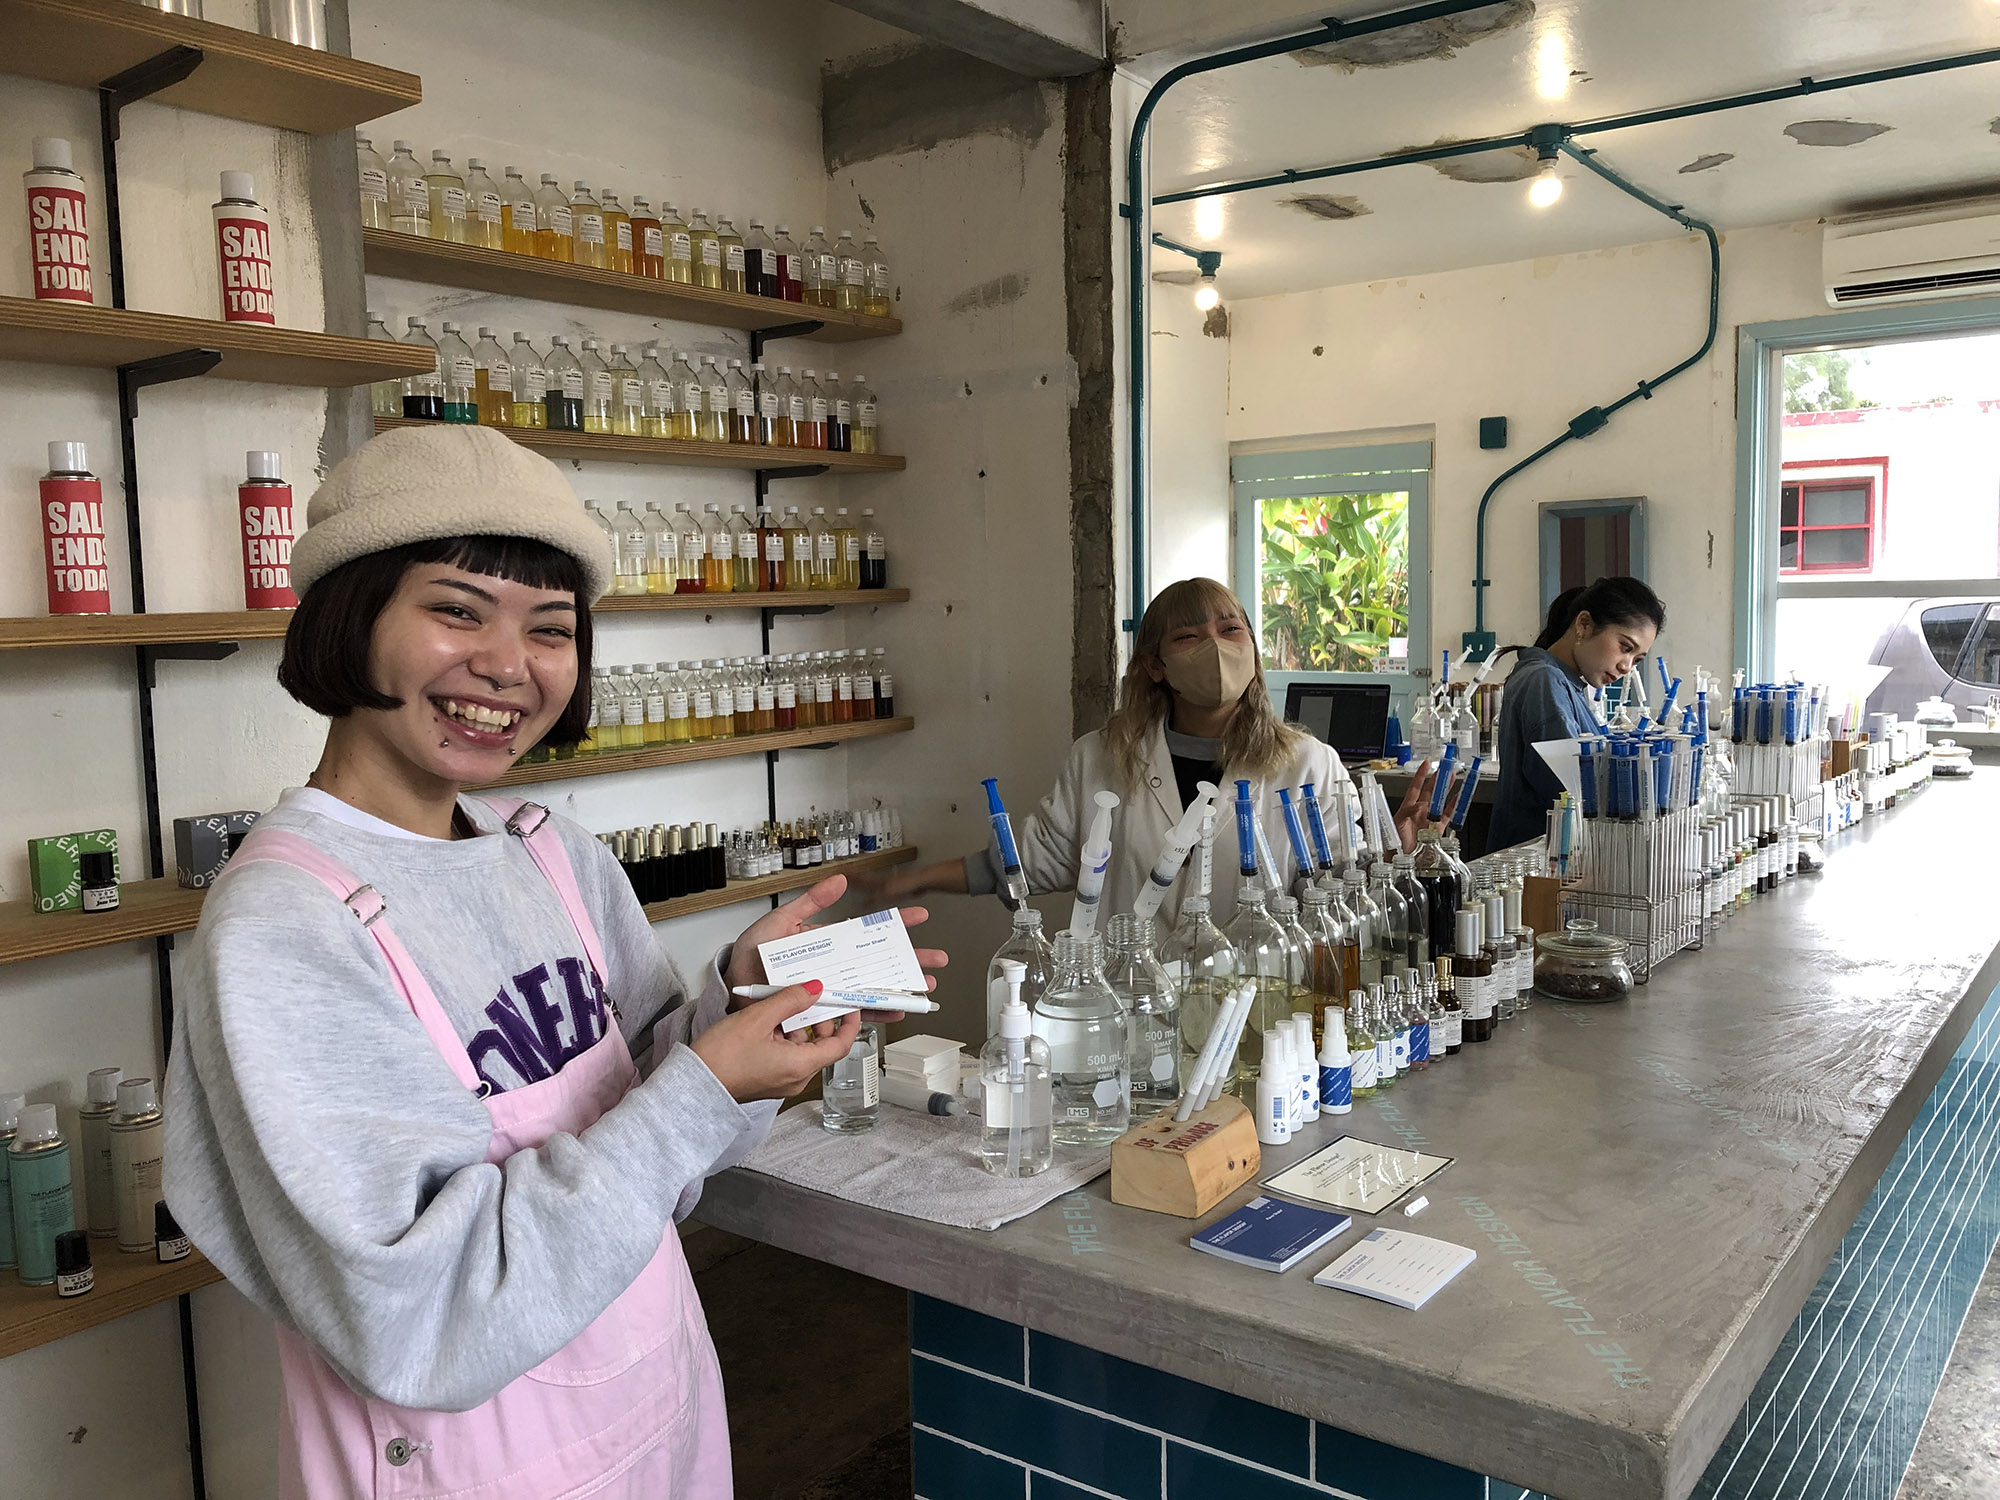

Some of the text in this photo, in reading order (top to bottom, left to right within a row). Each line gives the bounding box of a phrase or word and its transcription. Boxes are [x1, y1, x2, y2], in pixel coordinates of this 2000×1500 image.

[226, 260, 273, 291] END
[48, 501, 103, 535] SAL
[245, 505, 295, 536] SAL
[783, 949, 807, 959] FLAVOR
[1145, 1030, 1163, 1041] 500
[1087, 1054, 1107, 1066] 500
[1068, 1108, 1088, 1117] LMS
[1067, 1224, 1105, 1256] THE
[1453, 1196, 1650, 1389] DESIGN FLAVOR THE
